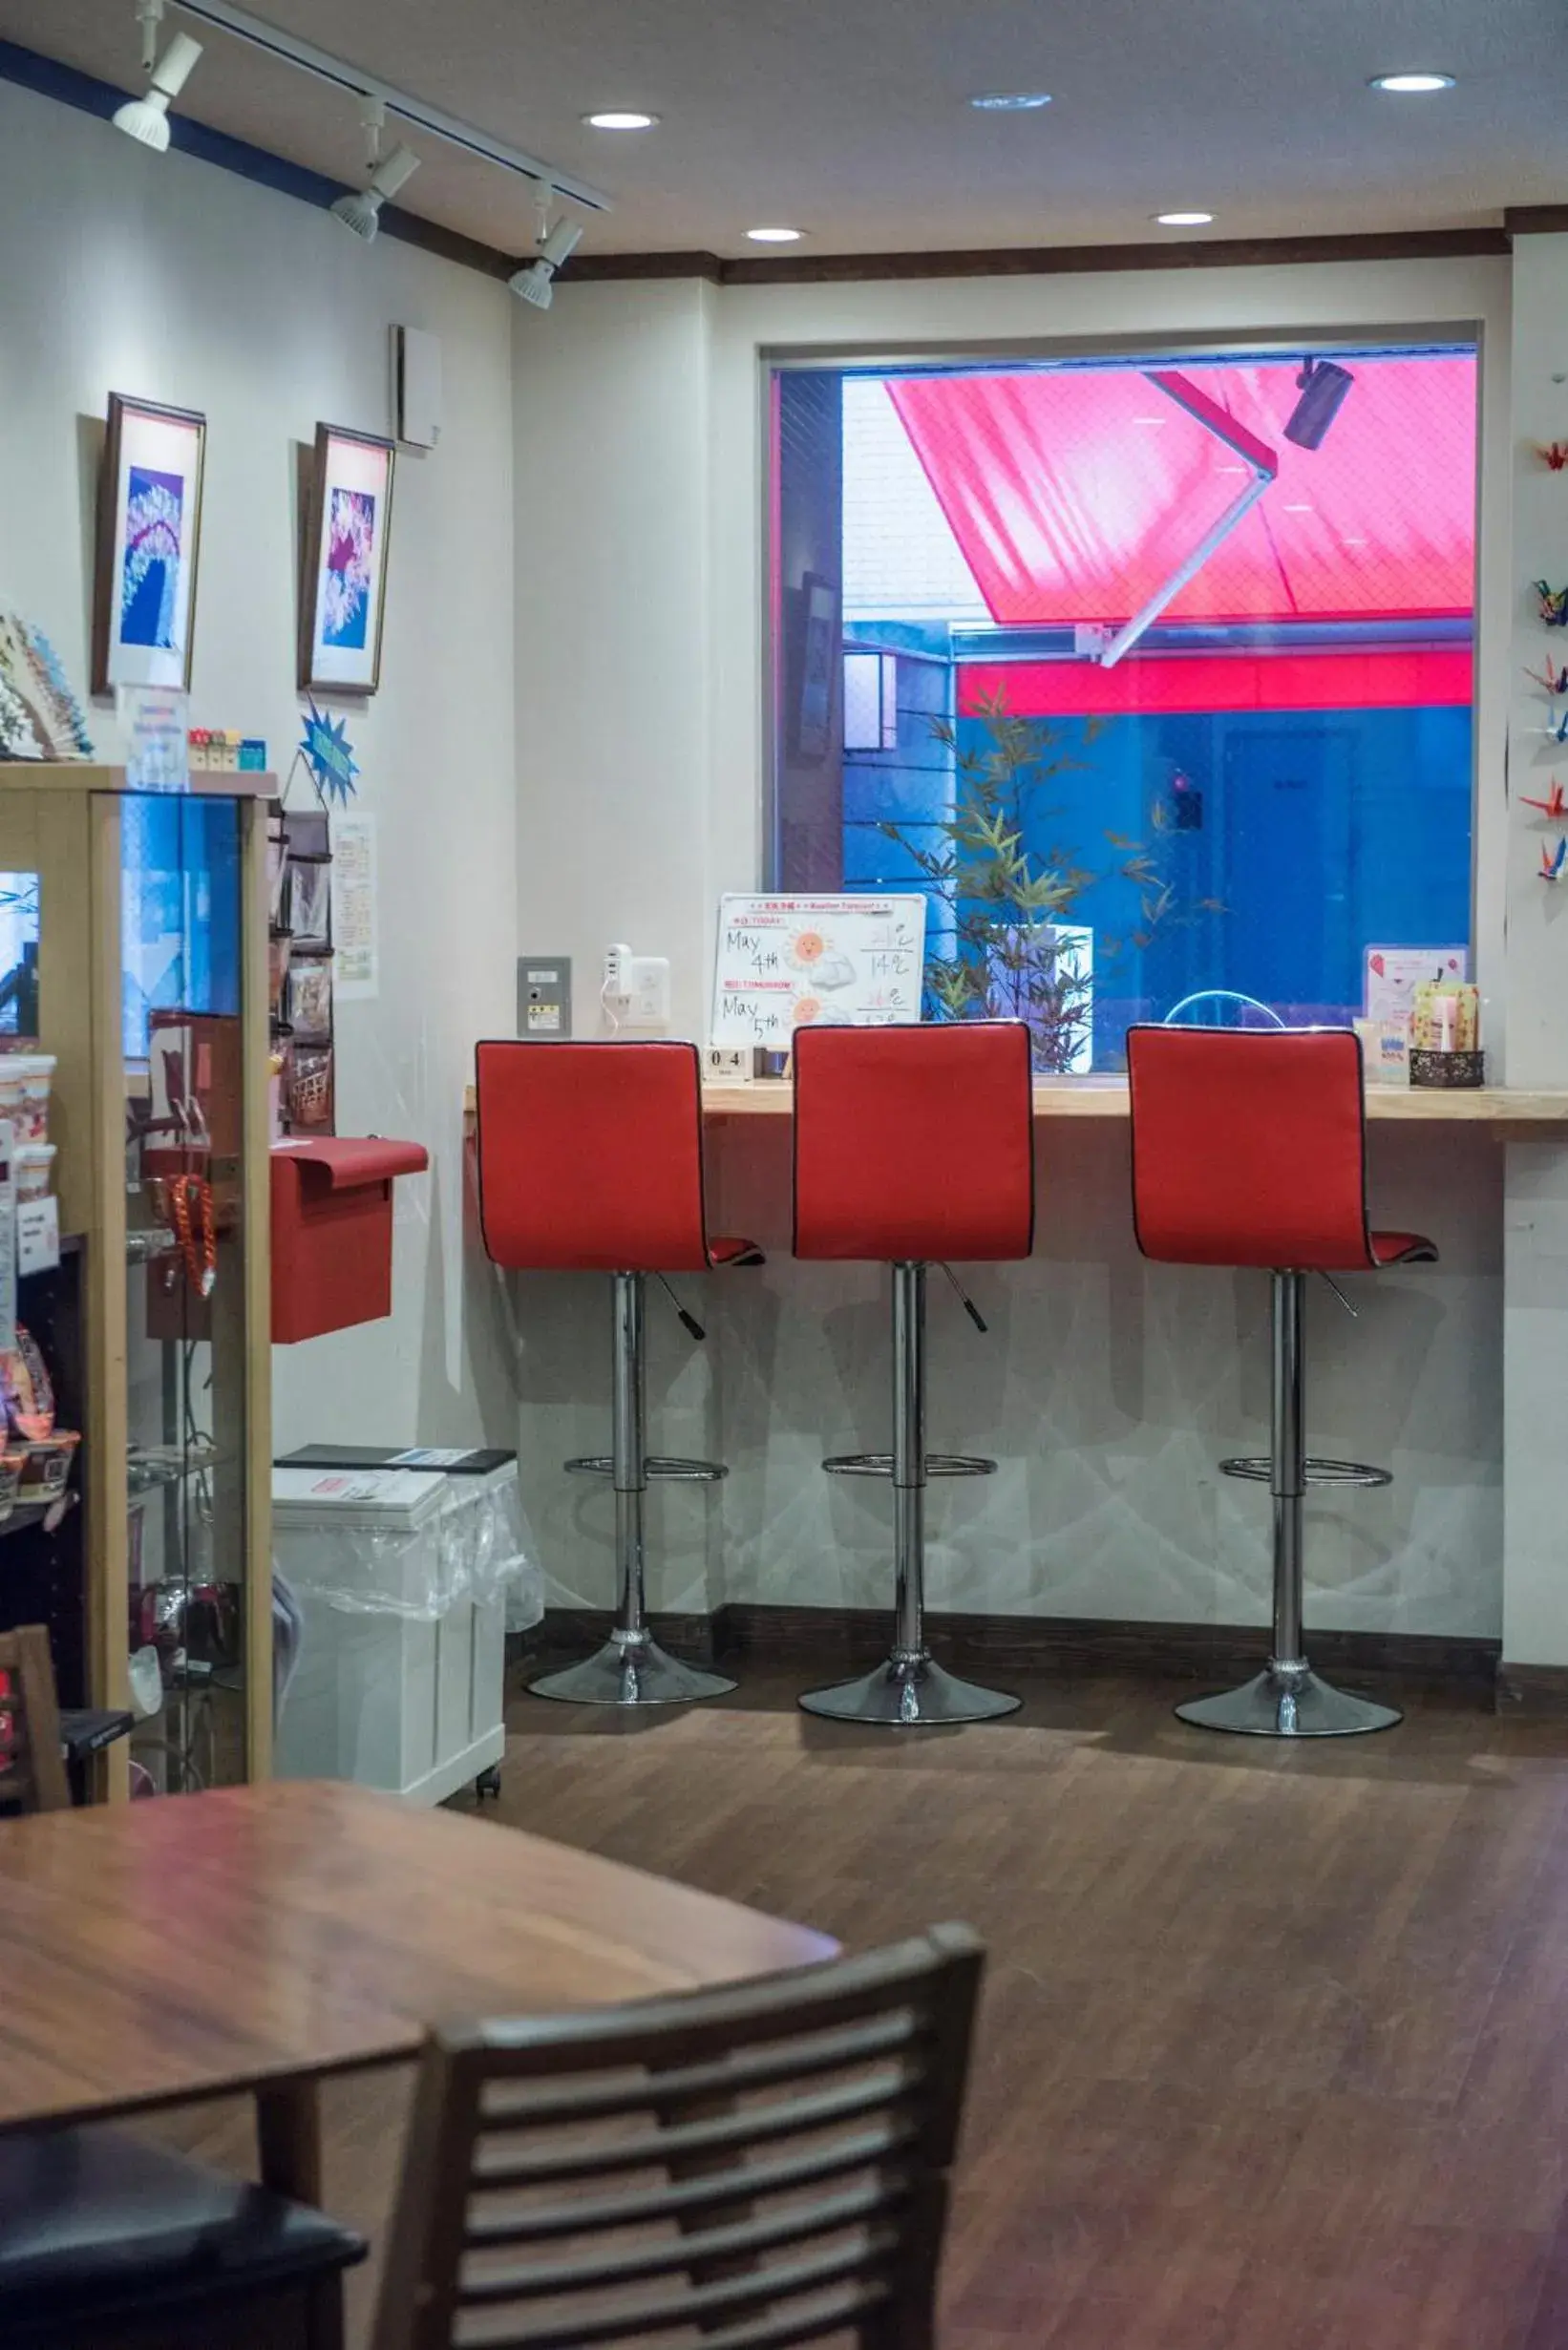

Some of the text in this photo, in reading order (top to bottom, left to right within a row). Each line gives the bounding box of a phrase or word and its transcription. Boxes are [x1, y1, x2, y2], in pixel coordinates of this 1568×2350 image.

[728, 930, 760, 956] May
[751, 952, 778, 974] 4th
[723, 996, 758, 1020] May
[753, 1014, 778, 1040] 5th
